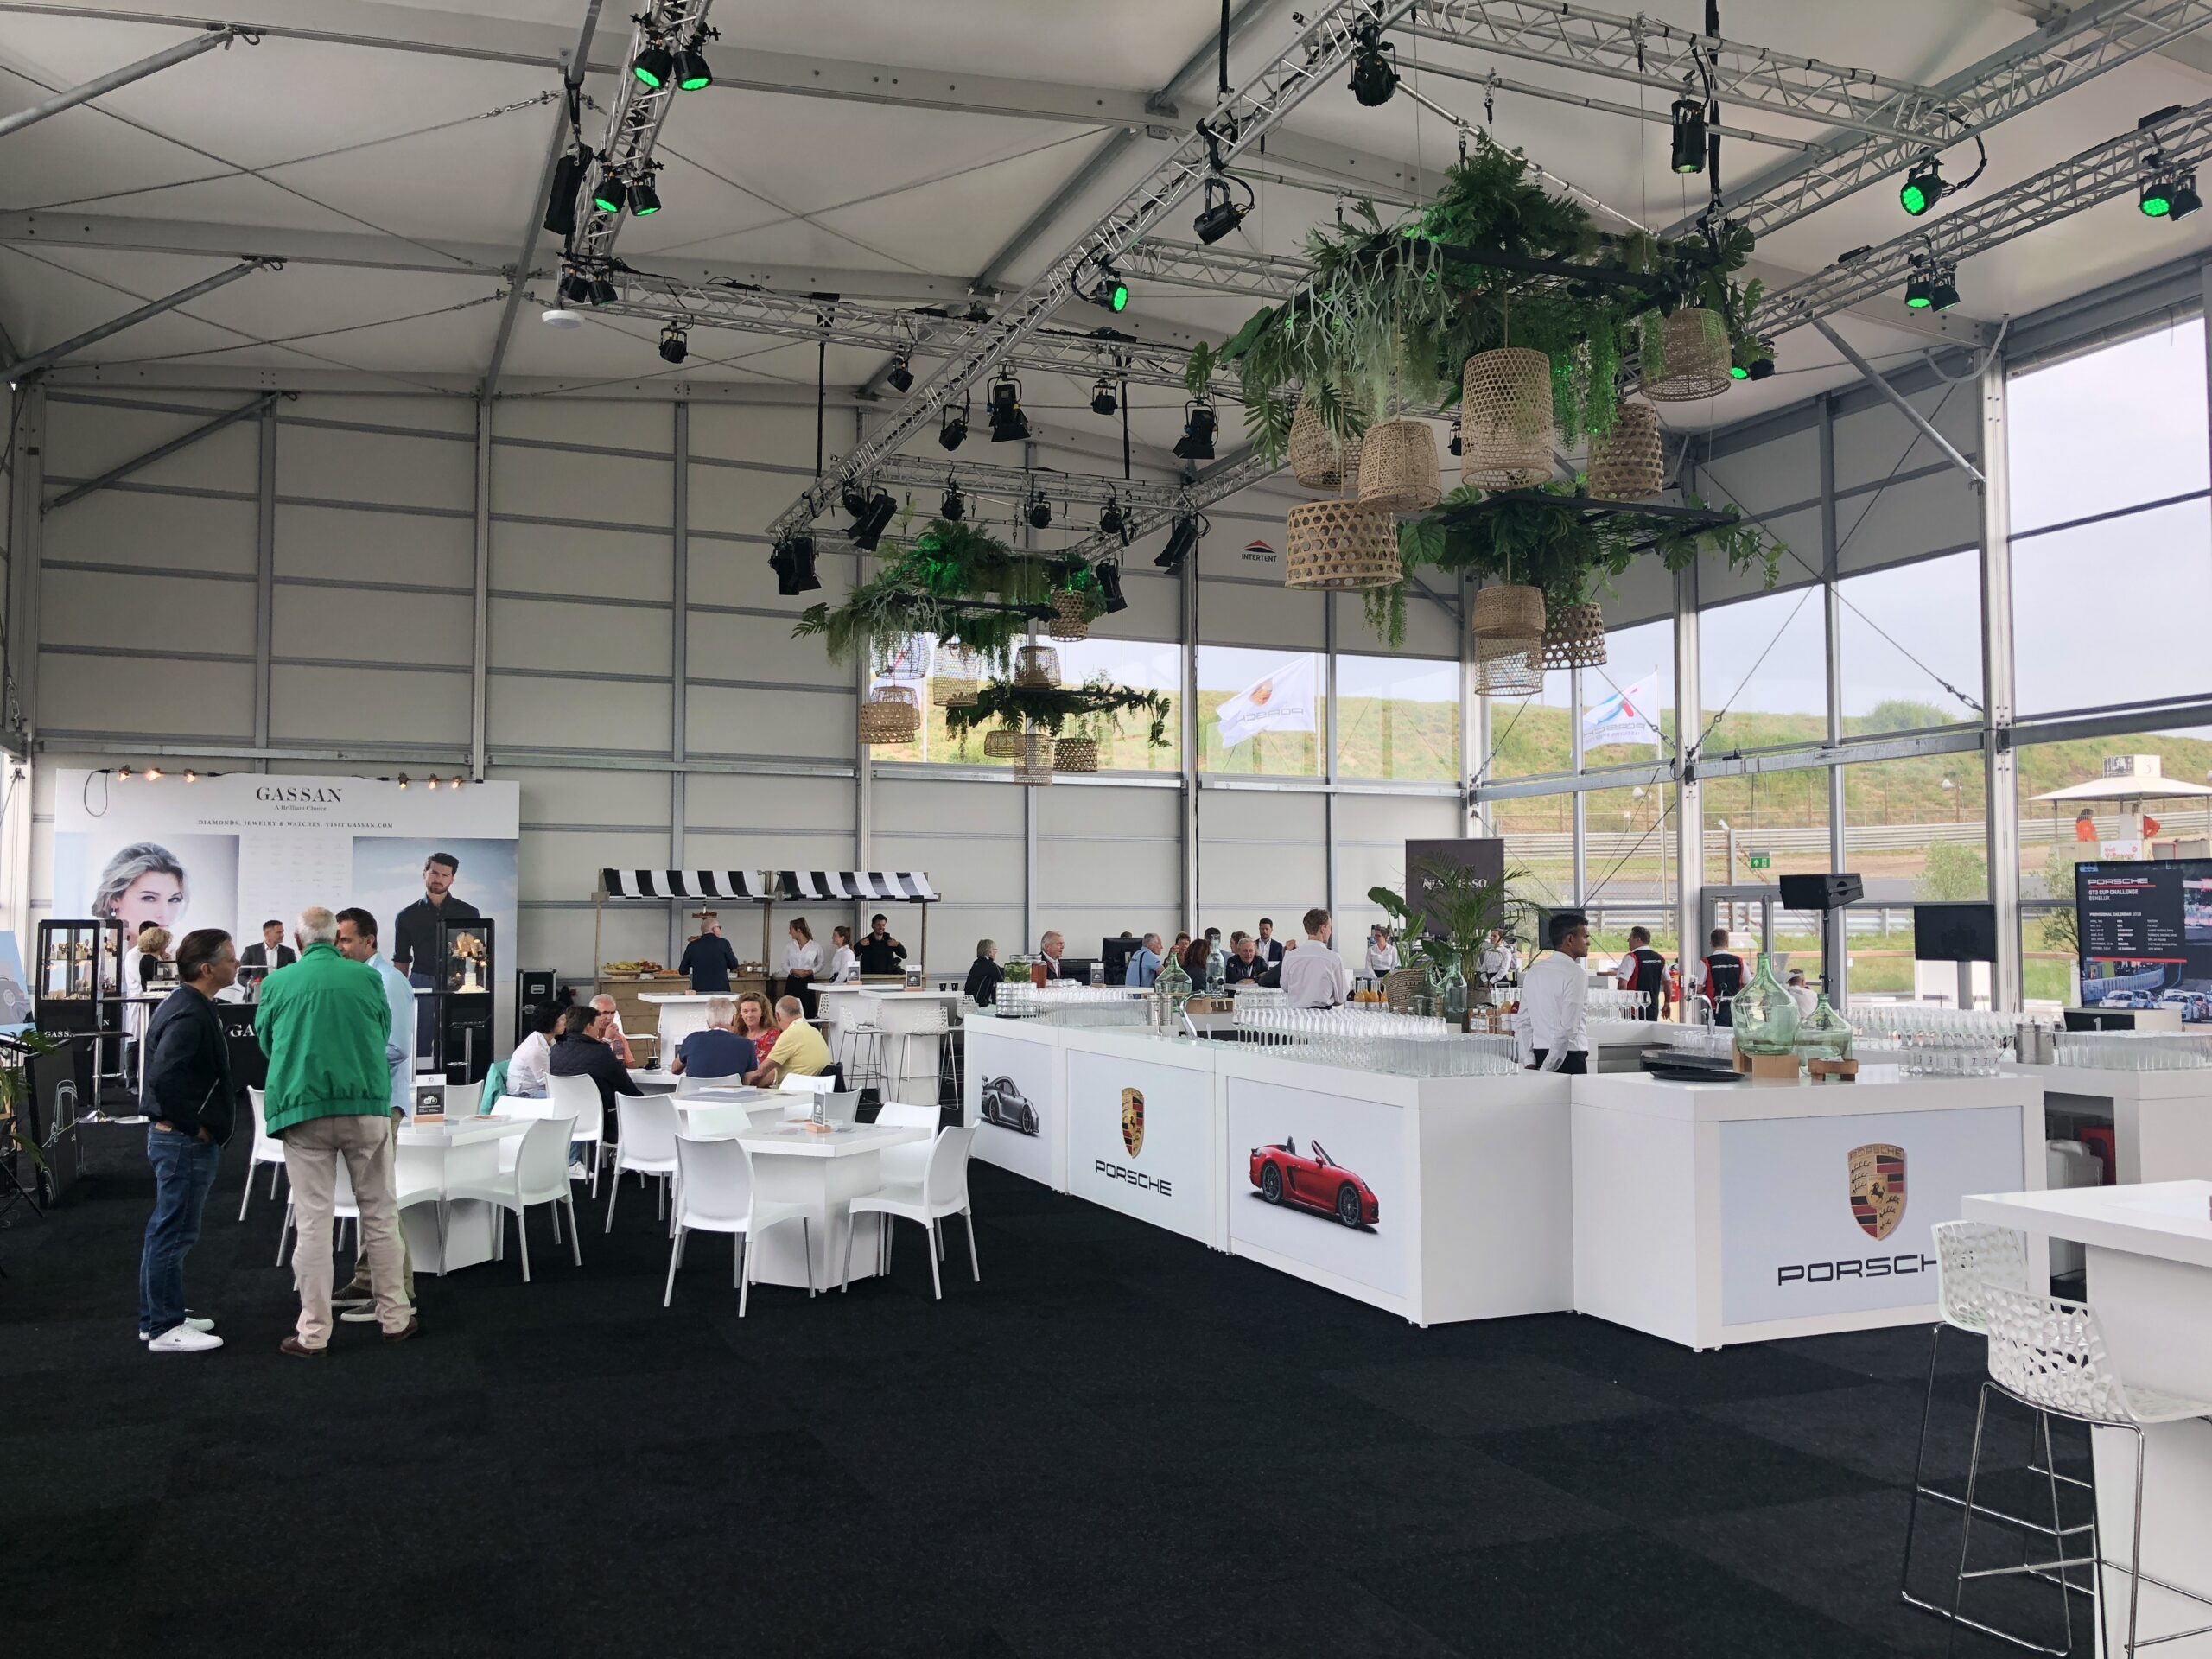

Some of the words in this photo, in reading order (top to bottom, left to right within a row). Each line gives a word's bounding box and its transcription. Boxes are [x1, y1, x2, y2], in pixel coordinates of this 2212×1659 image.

[1241, 554, 1277, 563] INTERTENT
[256, 786, 343, 803] GASSAN
[1096, 1160, 1172, 1197] PORSCHE
[1777, 1254, 1937, 1286] PORSCH
